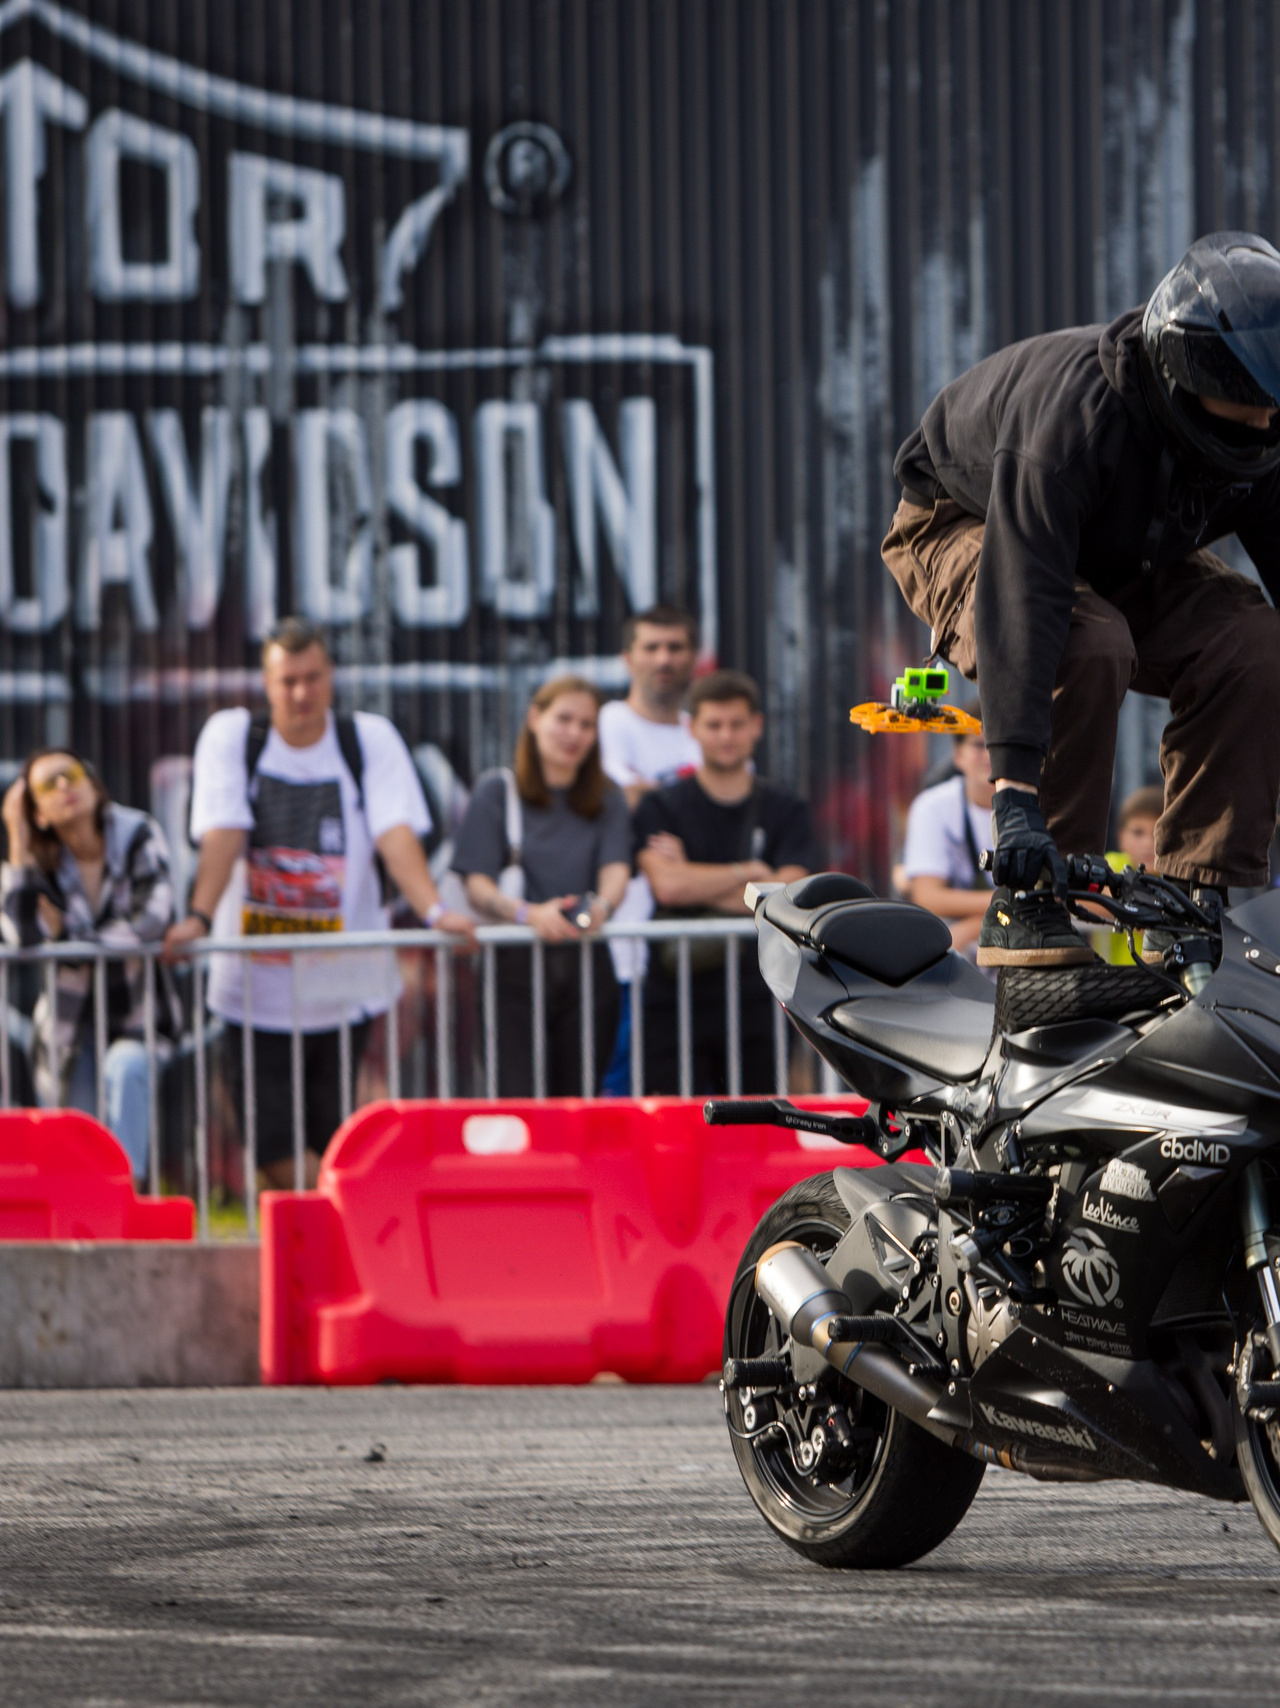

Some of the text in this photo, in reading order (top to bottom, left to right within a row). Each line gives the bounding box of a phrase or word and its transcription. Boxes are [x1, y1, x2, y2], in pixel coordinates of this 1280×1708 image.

[1160, 1136, 1231, 1164] cbdMD
[1082, 1191, 1140, 1232] LeoVince
[1061, 1307, 1127, 1336] HEATWAVE
[980, 1402, 1097, 1451] Kawasaki
